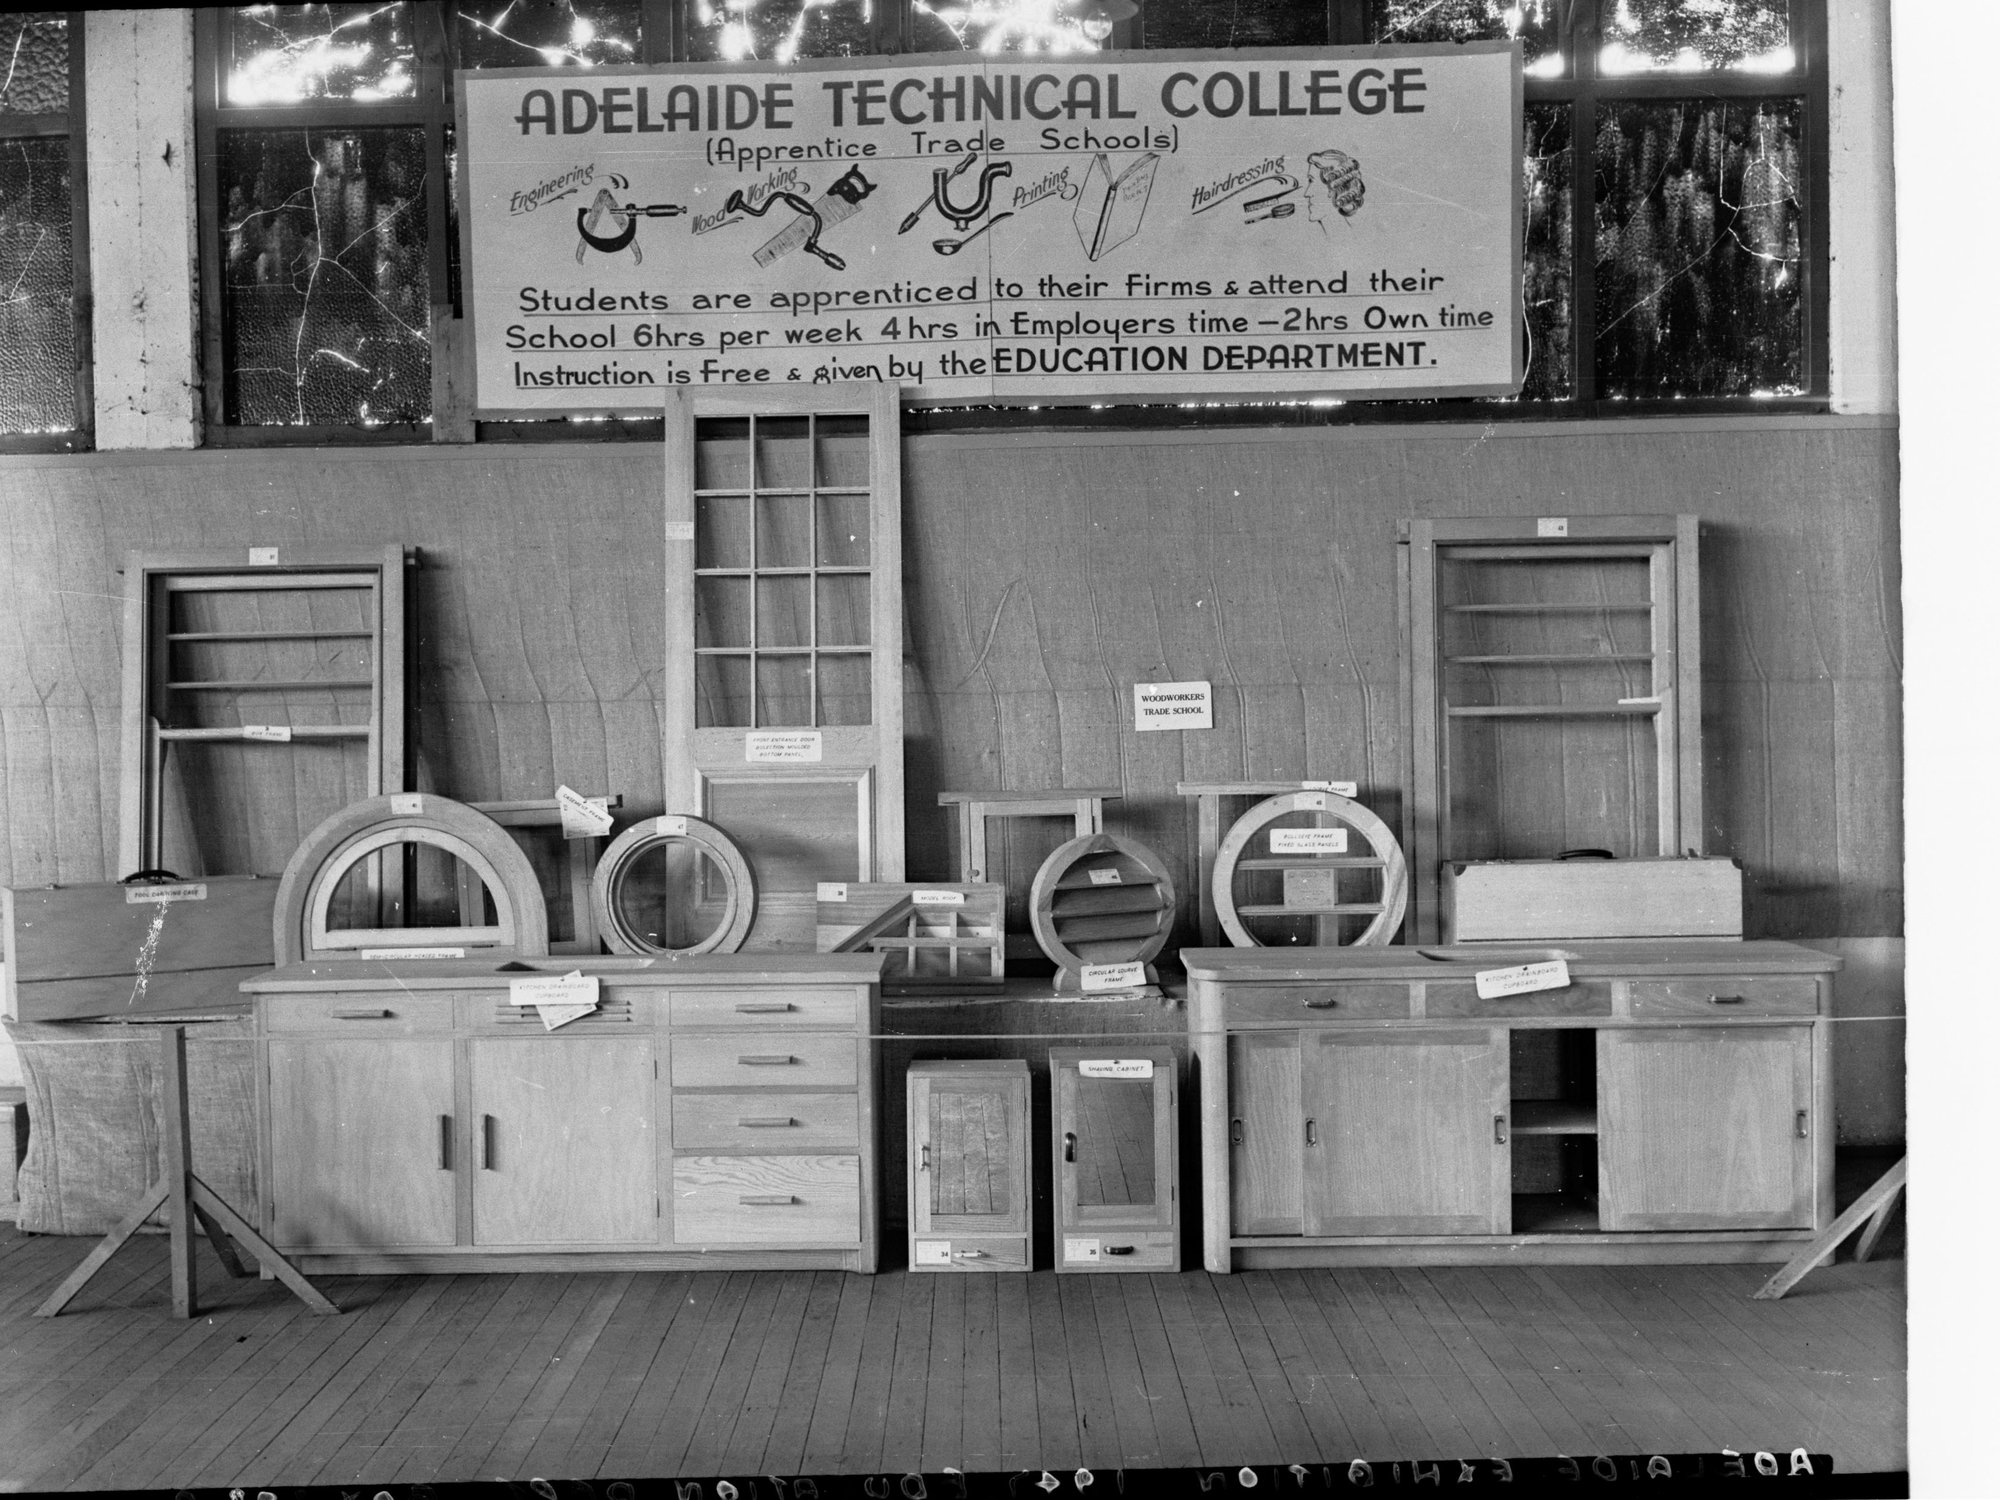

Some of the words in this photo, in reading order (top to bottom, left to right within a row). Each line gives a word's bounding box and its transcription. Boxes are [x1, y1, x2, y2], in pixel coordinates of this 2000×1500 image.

[514, 82, 794, 135] ADELAIDE
[823, 73, 1137, 127] TECHNICAL
[1161, 68, 1428, 118] COLLEGE
[706, 137, 878, 171] (Apprentice
[911, 129, 1006, 154] Trade
[1040, 124, 1178, 153] Schools)
[509, 163, 595, 213] Engineering
[691, 207, 727, 234] Wood
[744, 166, 798, 206] Working
[1013, 166, 1070, 208] Printing
[1191, 155, 1287, 209] Hairdressing
[519, 287, 669, 312] Students
[692, 290, 752, 309] are
[770, 276, 977, 316] apprenticed
[995, 279, 1024, 298] to
[1038, 274, 1109, 298] their
[1125, 273, 1212, 297] Firms
[1225, 281, 1239, 295] &
[1249, 271, 1348, 295] attend
[1370, 268, 1444, 293] their
[506, 325, 616, 349] School
[633, 323, 705, 347] 6hrs
[720, 326, 770, 354] per
[785, 318, 863, 343] week
[976, 316, 1001, 338] in
[1011, 311, 1176, 346] Employers
[1188, 311, 1249, 333] time
[1364, 305, 1429, 329] Own
[1439, 304, 1494, 328] time
[514, 361, 655, 387] Instruction
[667, 362, 692, 385] is
[700, 359, 771, 384] Free
[787, 367, 802, 382] &
[813, 358, 884, 386] given
[888, 355, 924, 385] by
[940, 354, 987, 376] the
[993, 346, 1188, 373] EDUCATION
[1203, 341, 1438, 370] DEPARTMENT.
[1141, 693, 1205, 702] WOODWORKERS
[1144, 708, 1170, 716] TRADE
[1172, 707, 1204, 715] SCHOOL
[1485, 974, 1512, 982] KITCHEN
